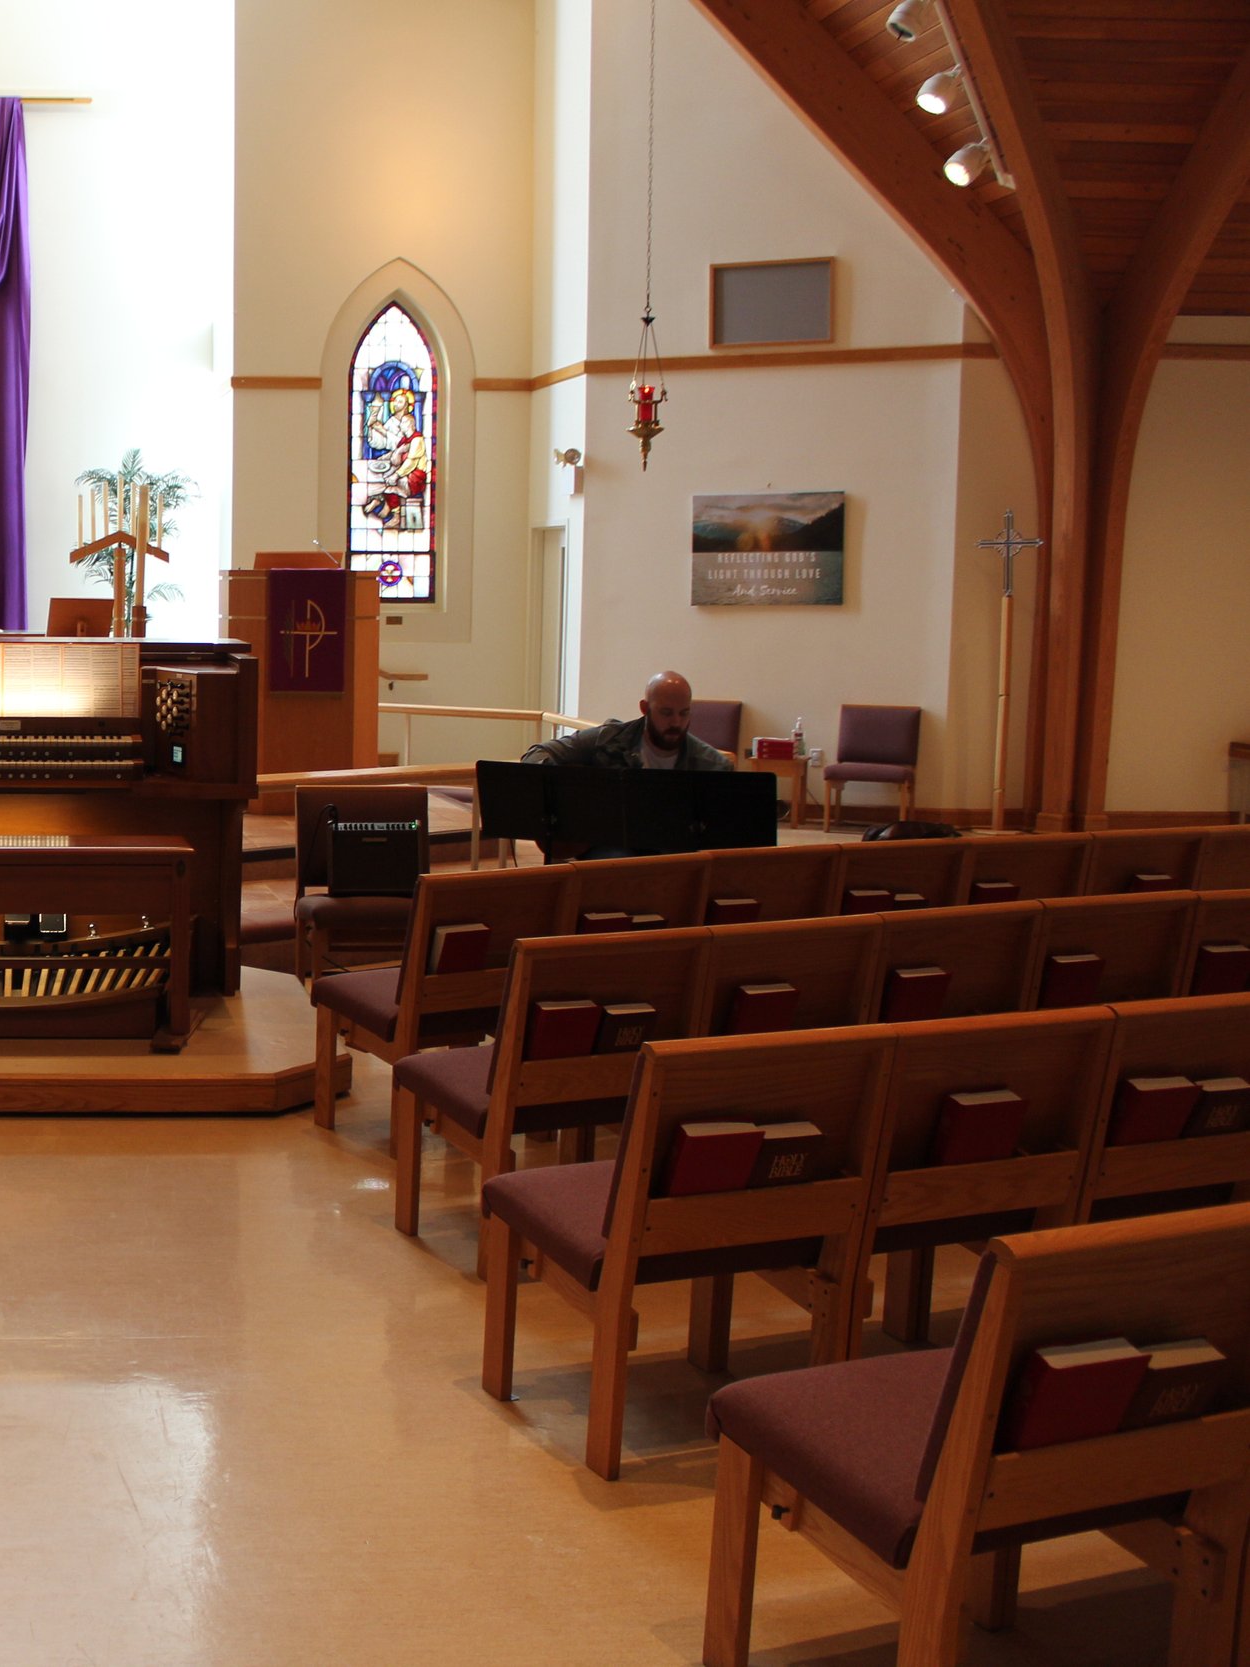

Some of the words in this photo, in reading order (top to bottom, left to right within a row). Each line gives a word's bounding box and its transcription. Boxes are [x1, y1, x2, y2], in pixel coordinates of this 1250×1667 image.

[717, 552, 779, 563] REFLECTING
[784, 552, 817, 562] GOD'S
[708, 569, 737, 580] LIGHT
[743, 569, 790, 579] THROUGH
[795, 568, 821, 579] LOVE
[732, 583, 756, 597] And
[759, 585, 798, 596] Service
[771, 1152, 809, 1168] HOLY
[768, 1164, 803, 1179] BIBLE
